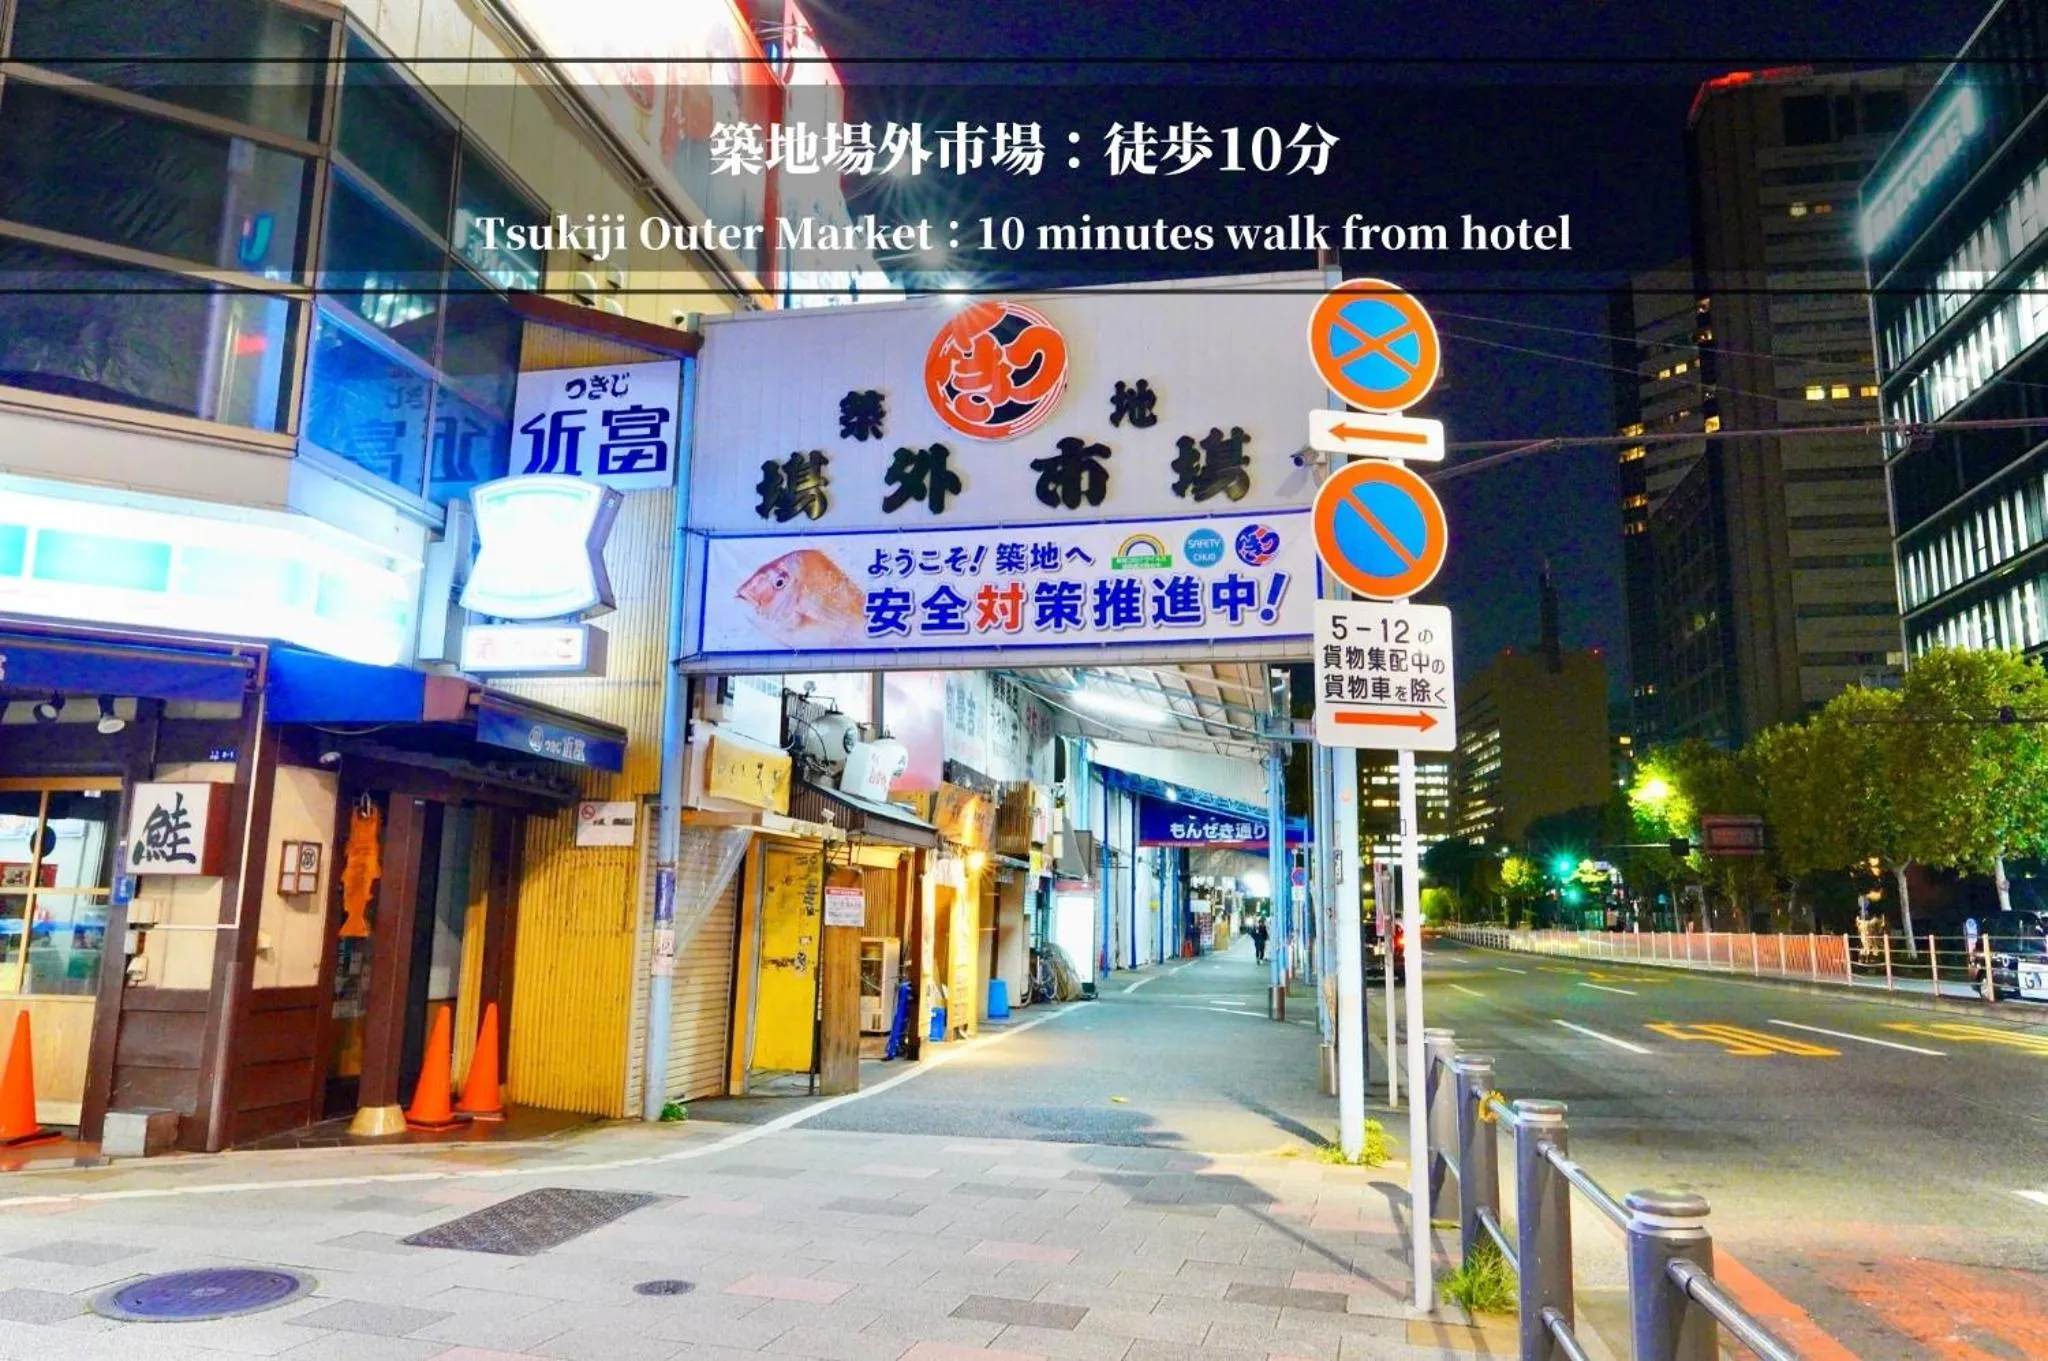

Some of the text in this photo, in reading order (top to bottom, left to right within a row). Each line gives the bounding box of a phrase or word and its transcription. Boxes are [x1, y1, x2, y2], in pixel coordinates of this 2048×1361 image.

[565, 371, 630, 402] つきじ
[865, 573, 1290, 634] 安全対策推進中!
[1322, 644, 1446, 676] 貨物集配中の
[1322, 673, 1447, 705] 貨物車を除く
[133, 791, 197, 866] 鮭
[1169, 821, 1267, 840] もんぜき通り
